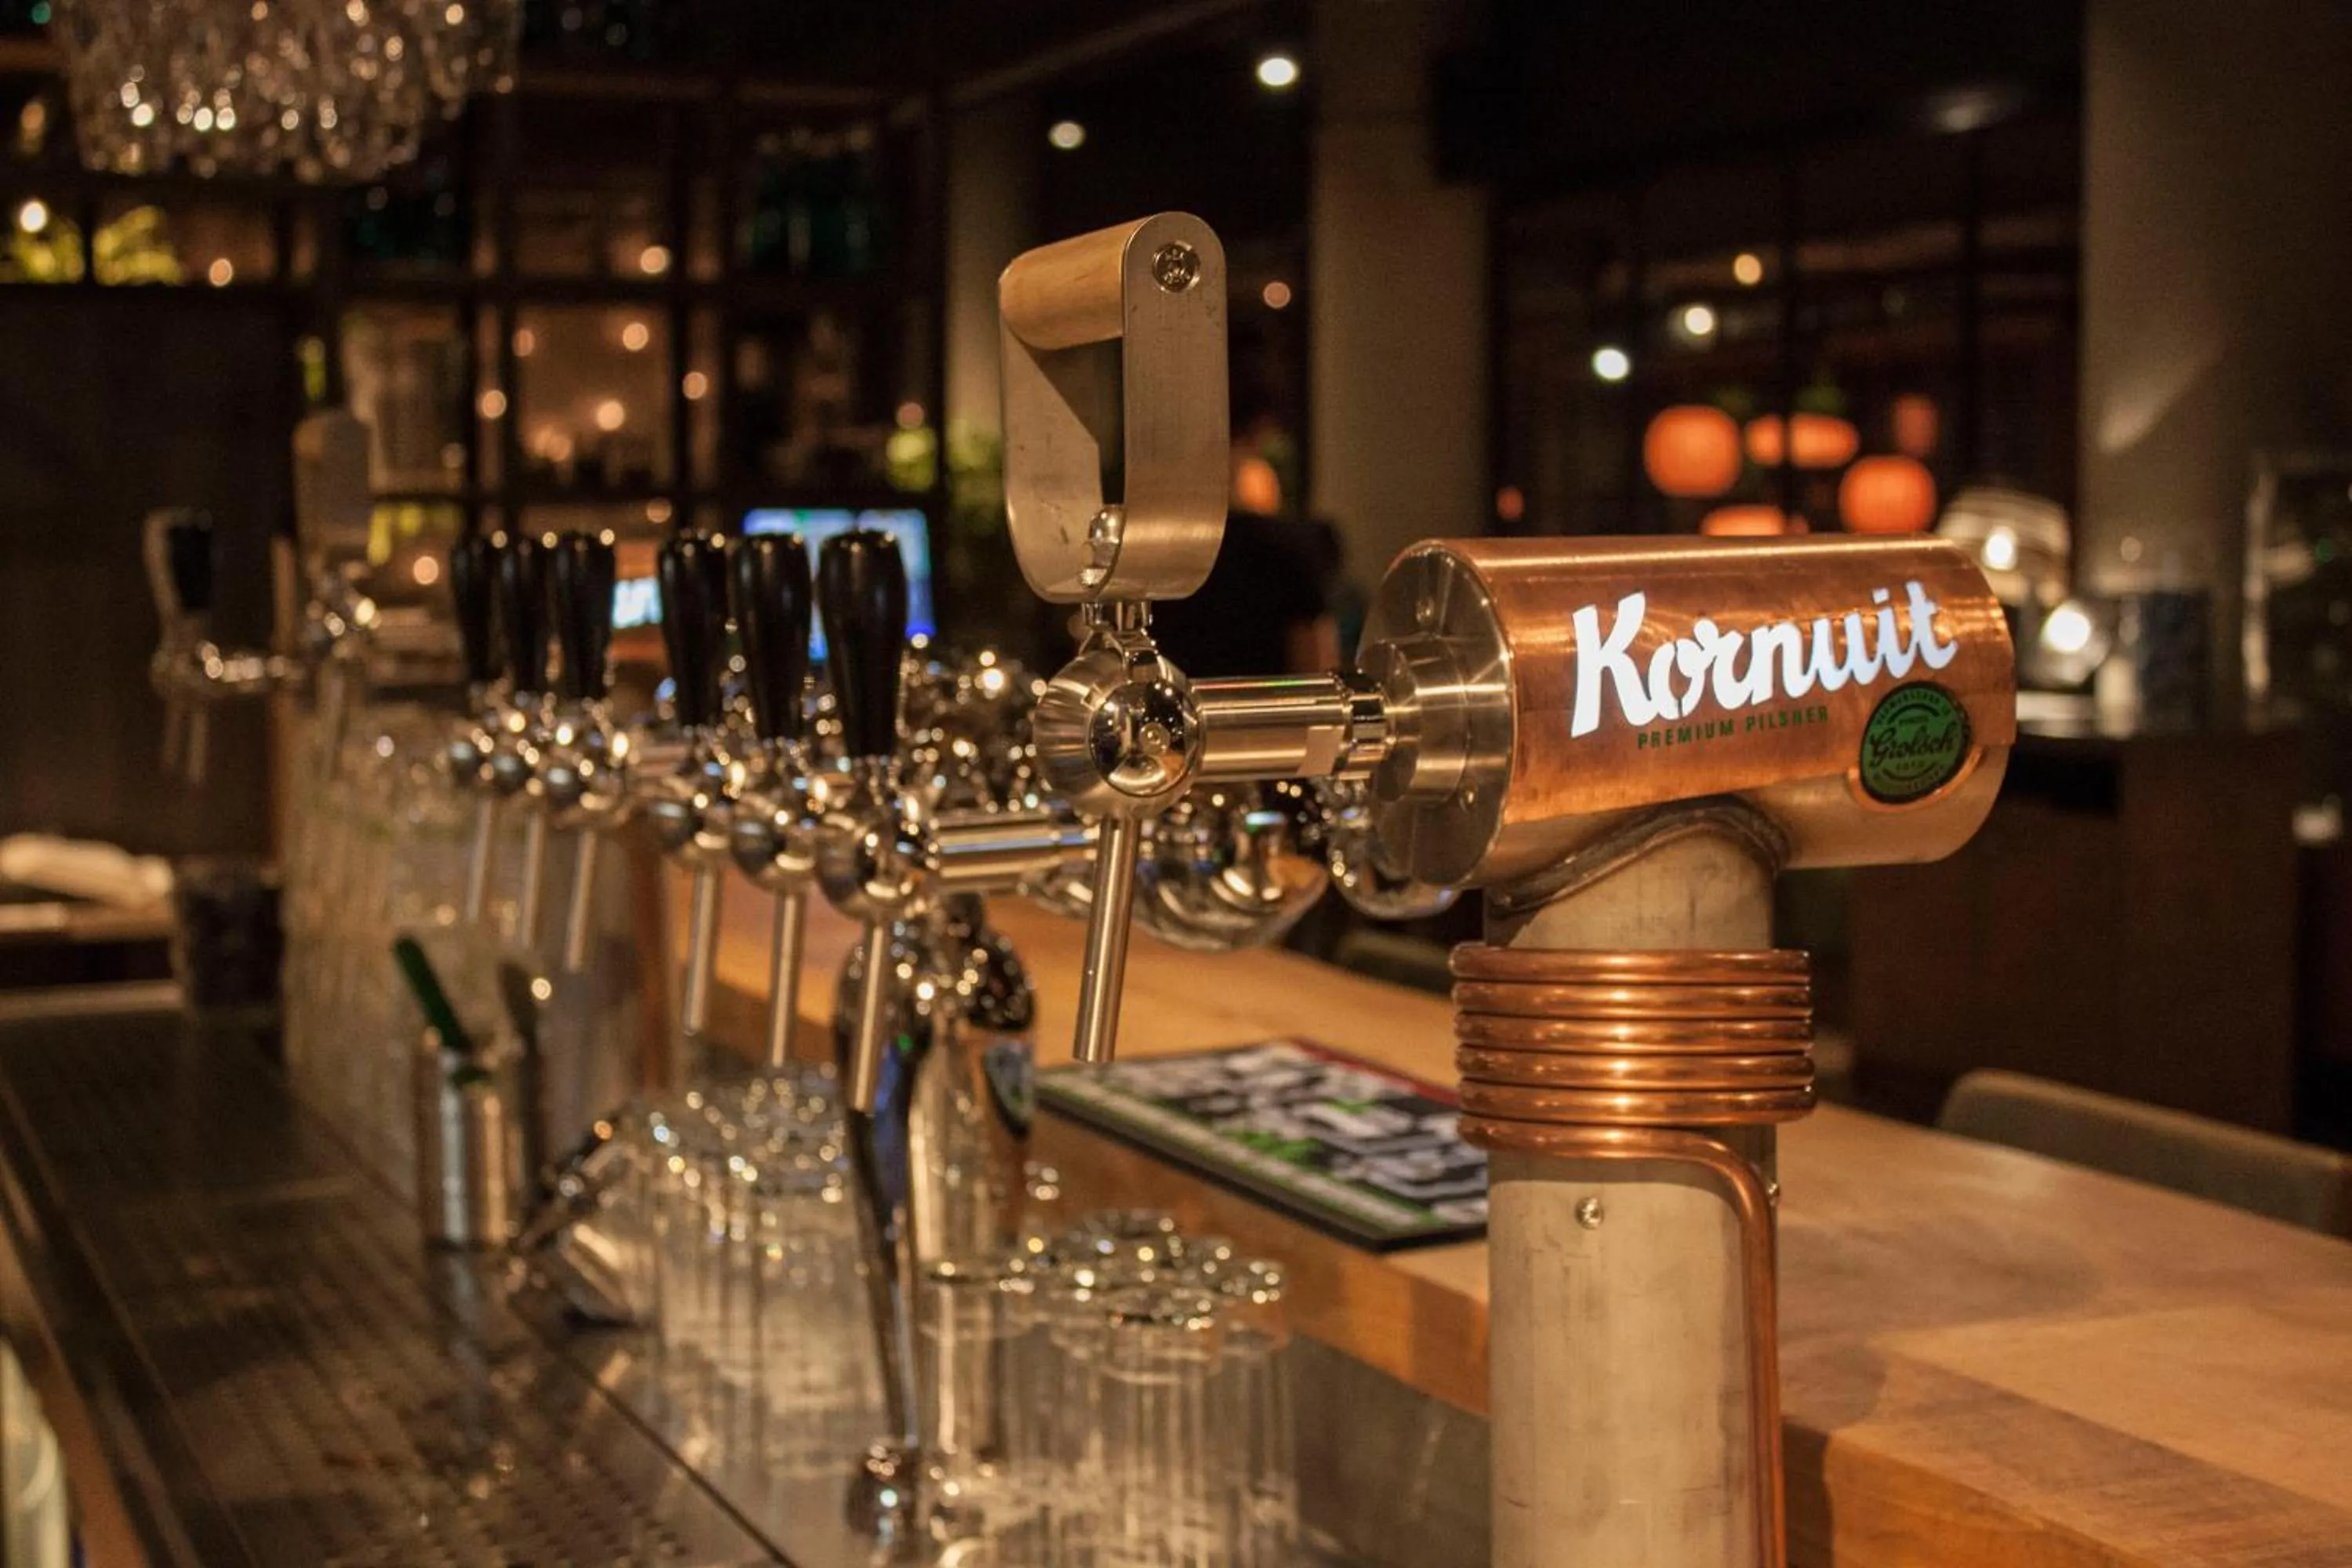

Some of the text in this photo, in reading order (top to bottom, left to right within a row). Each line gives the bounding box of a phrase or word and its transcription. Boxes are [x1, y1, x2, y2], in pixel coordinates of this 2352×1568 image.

[1571, 581, 1958, 737] Kornuit
[1638, 706, 1828, 750] PREMIUM PILSNER
[1869, 720, 1958, 767] Grolsch
